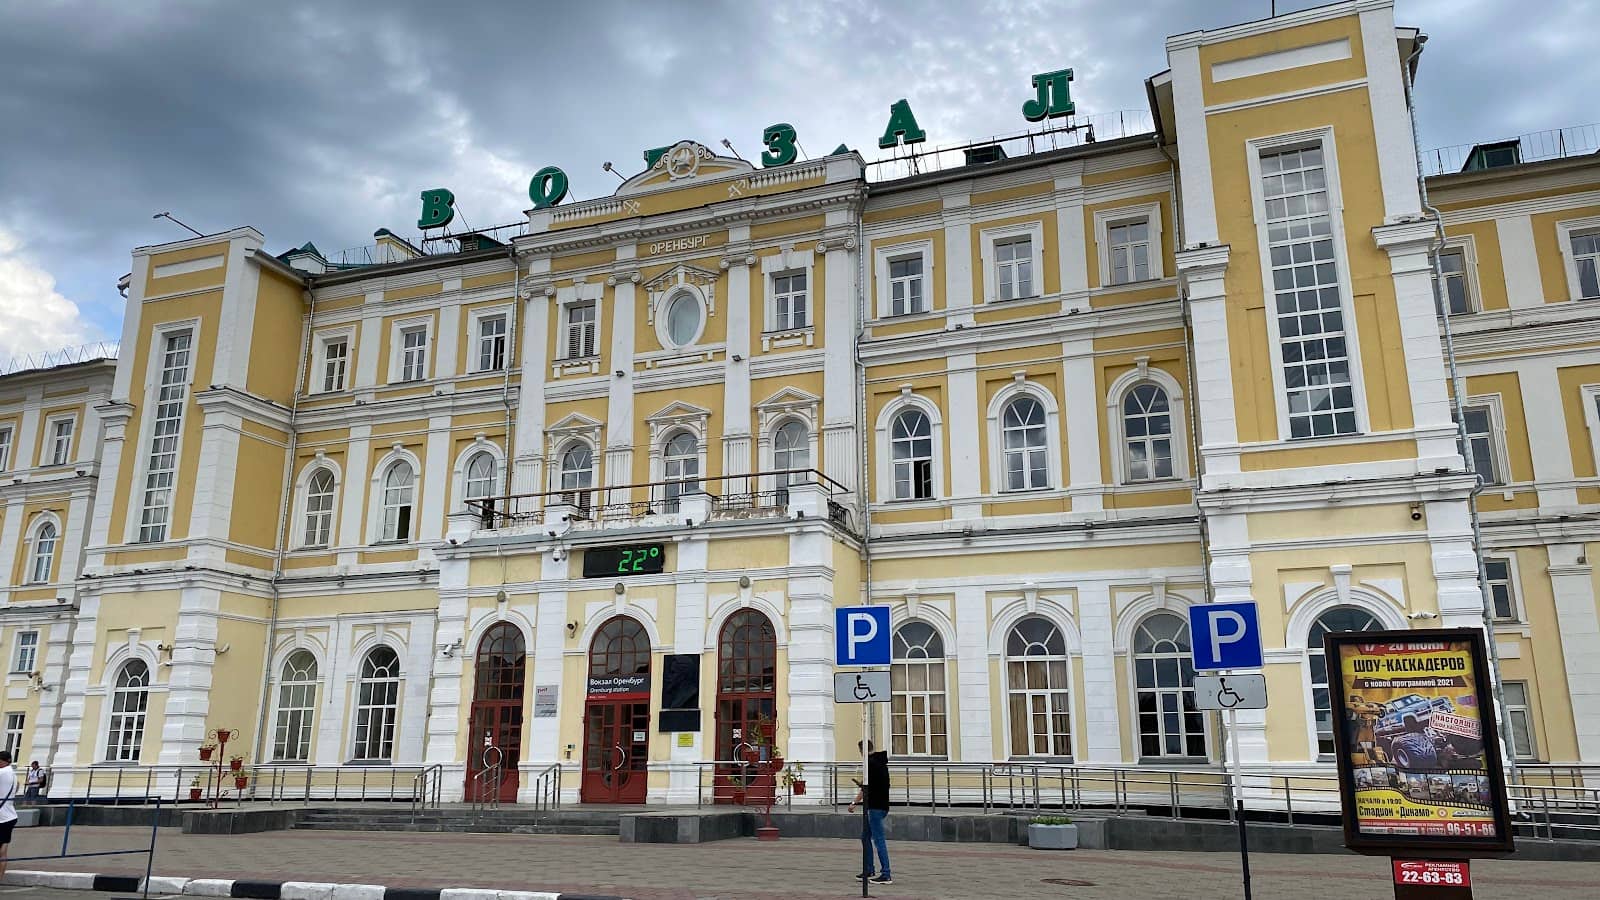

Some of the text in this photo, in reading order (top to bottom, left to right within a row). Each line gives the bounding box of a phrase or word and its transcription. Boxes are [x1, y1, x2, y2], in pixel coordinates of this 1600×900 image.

[650, 235, 710, 255] ОРЕНБУРГ
[618, 547, 659, 571] 22°
[848, 613, 878, 659] P
[1207, 610, 1247, 663] P
[1353, 657, 1465, 673] ШОУ-КАСКАДЕРОВ
[613, 677, 644, 686] Оренбург
[1392, 679, 1436, 689] программой
[1437, 678, 1454, 686] 2021
[1359, 806, 1393, 817] Стадион
